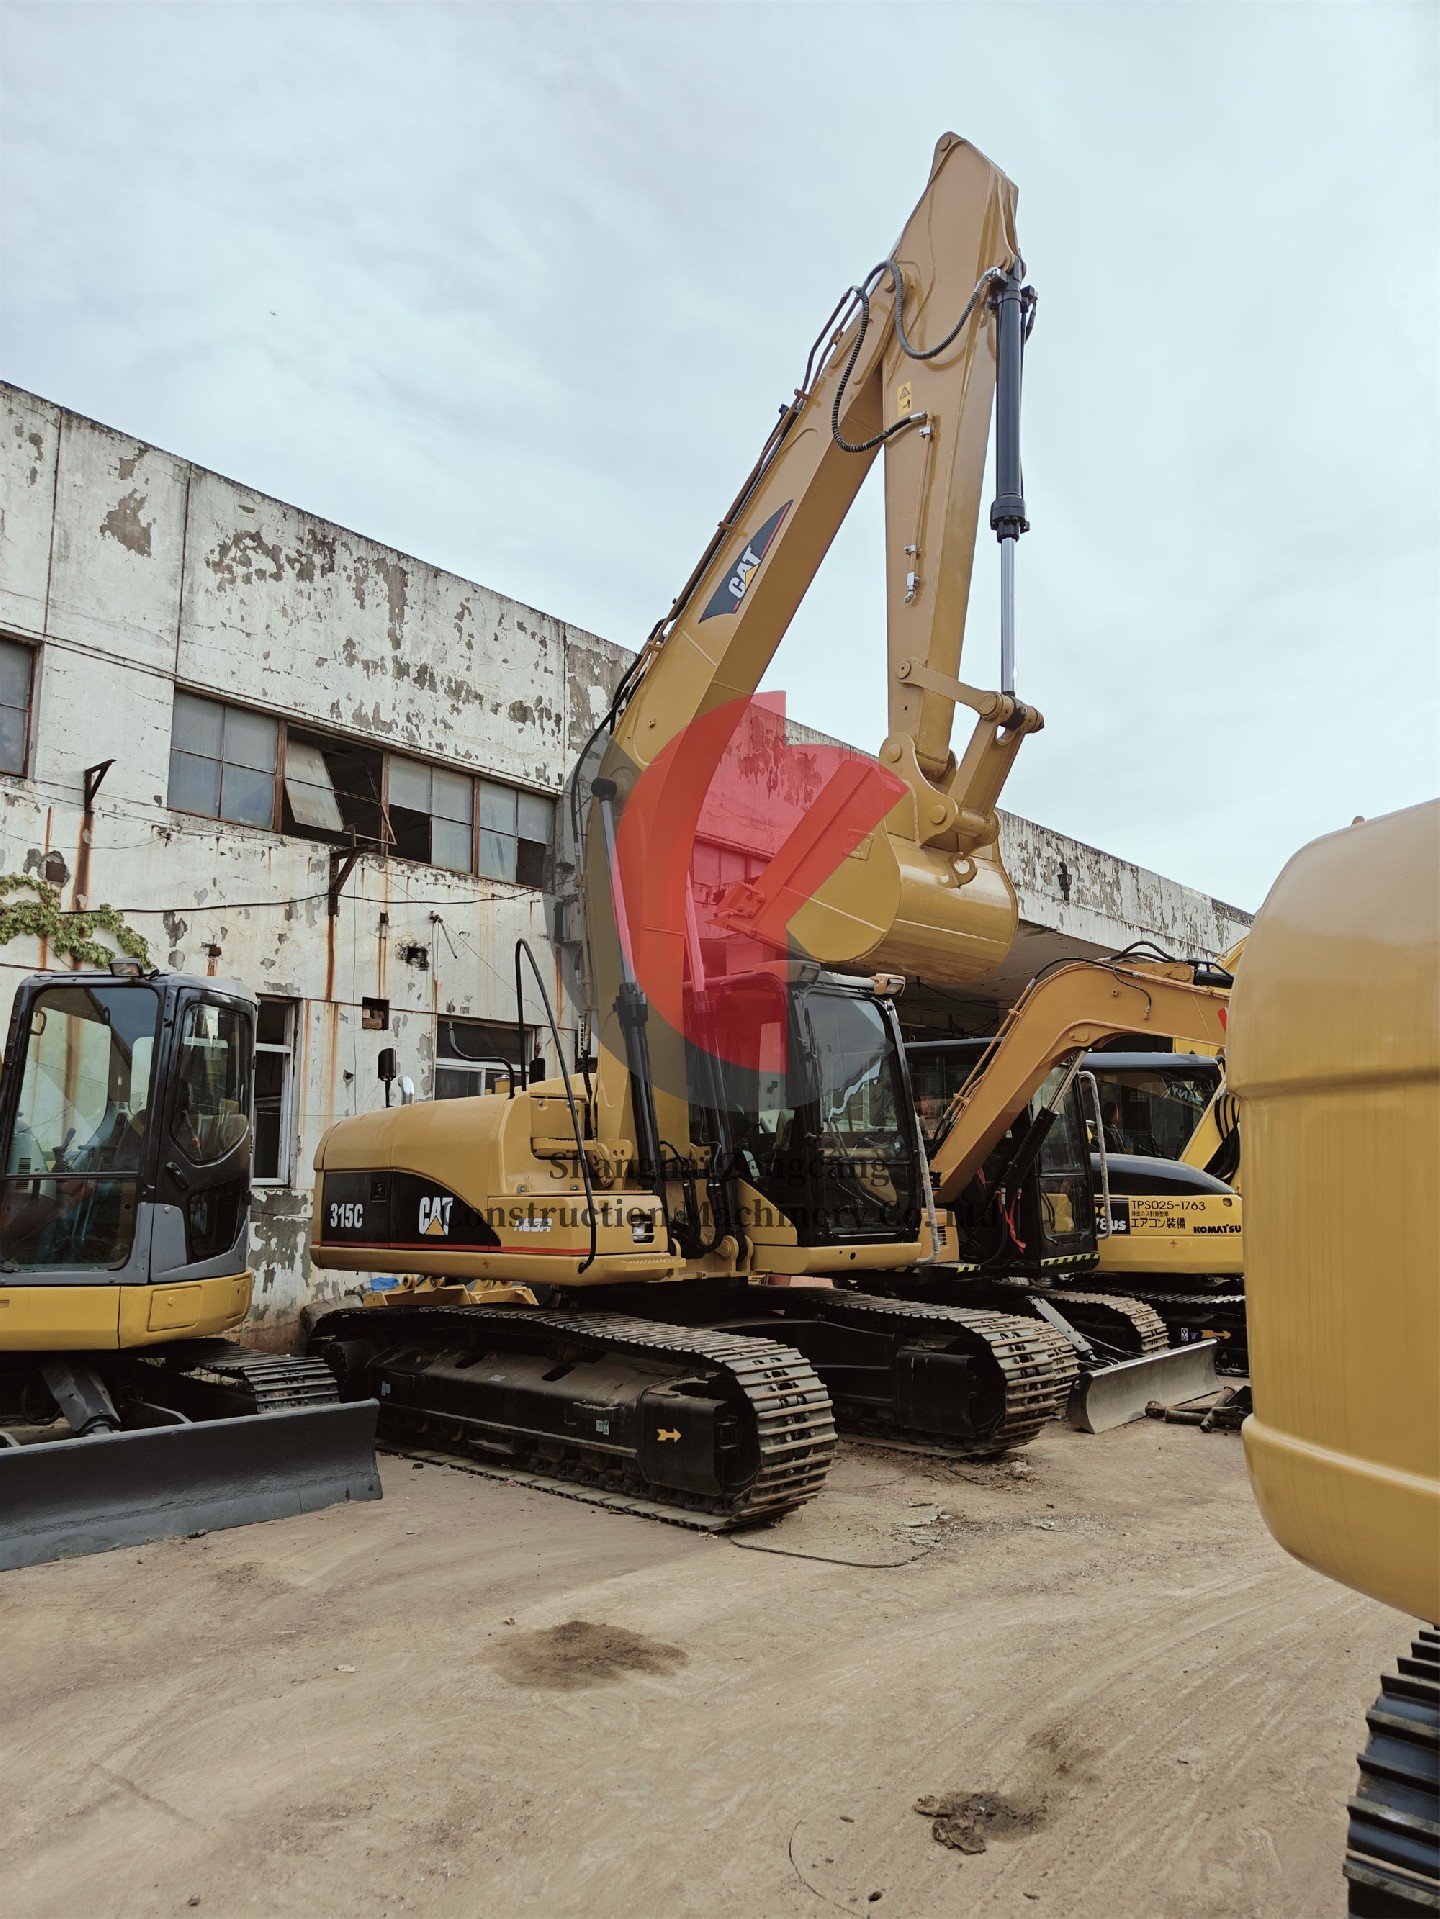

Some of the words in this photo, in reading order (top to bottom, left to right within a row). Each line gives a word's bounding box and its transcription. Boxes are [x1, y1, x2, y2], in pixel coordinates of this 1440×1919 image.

[728, 544, 762, 599] CAT
[330, 1203, 363, 1228] 315C
[419, 1196, 454, 1235] CAT
[1193, 1224, 1242, 1234] KOMATSU
